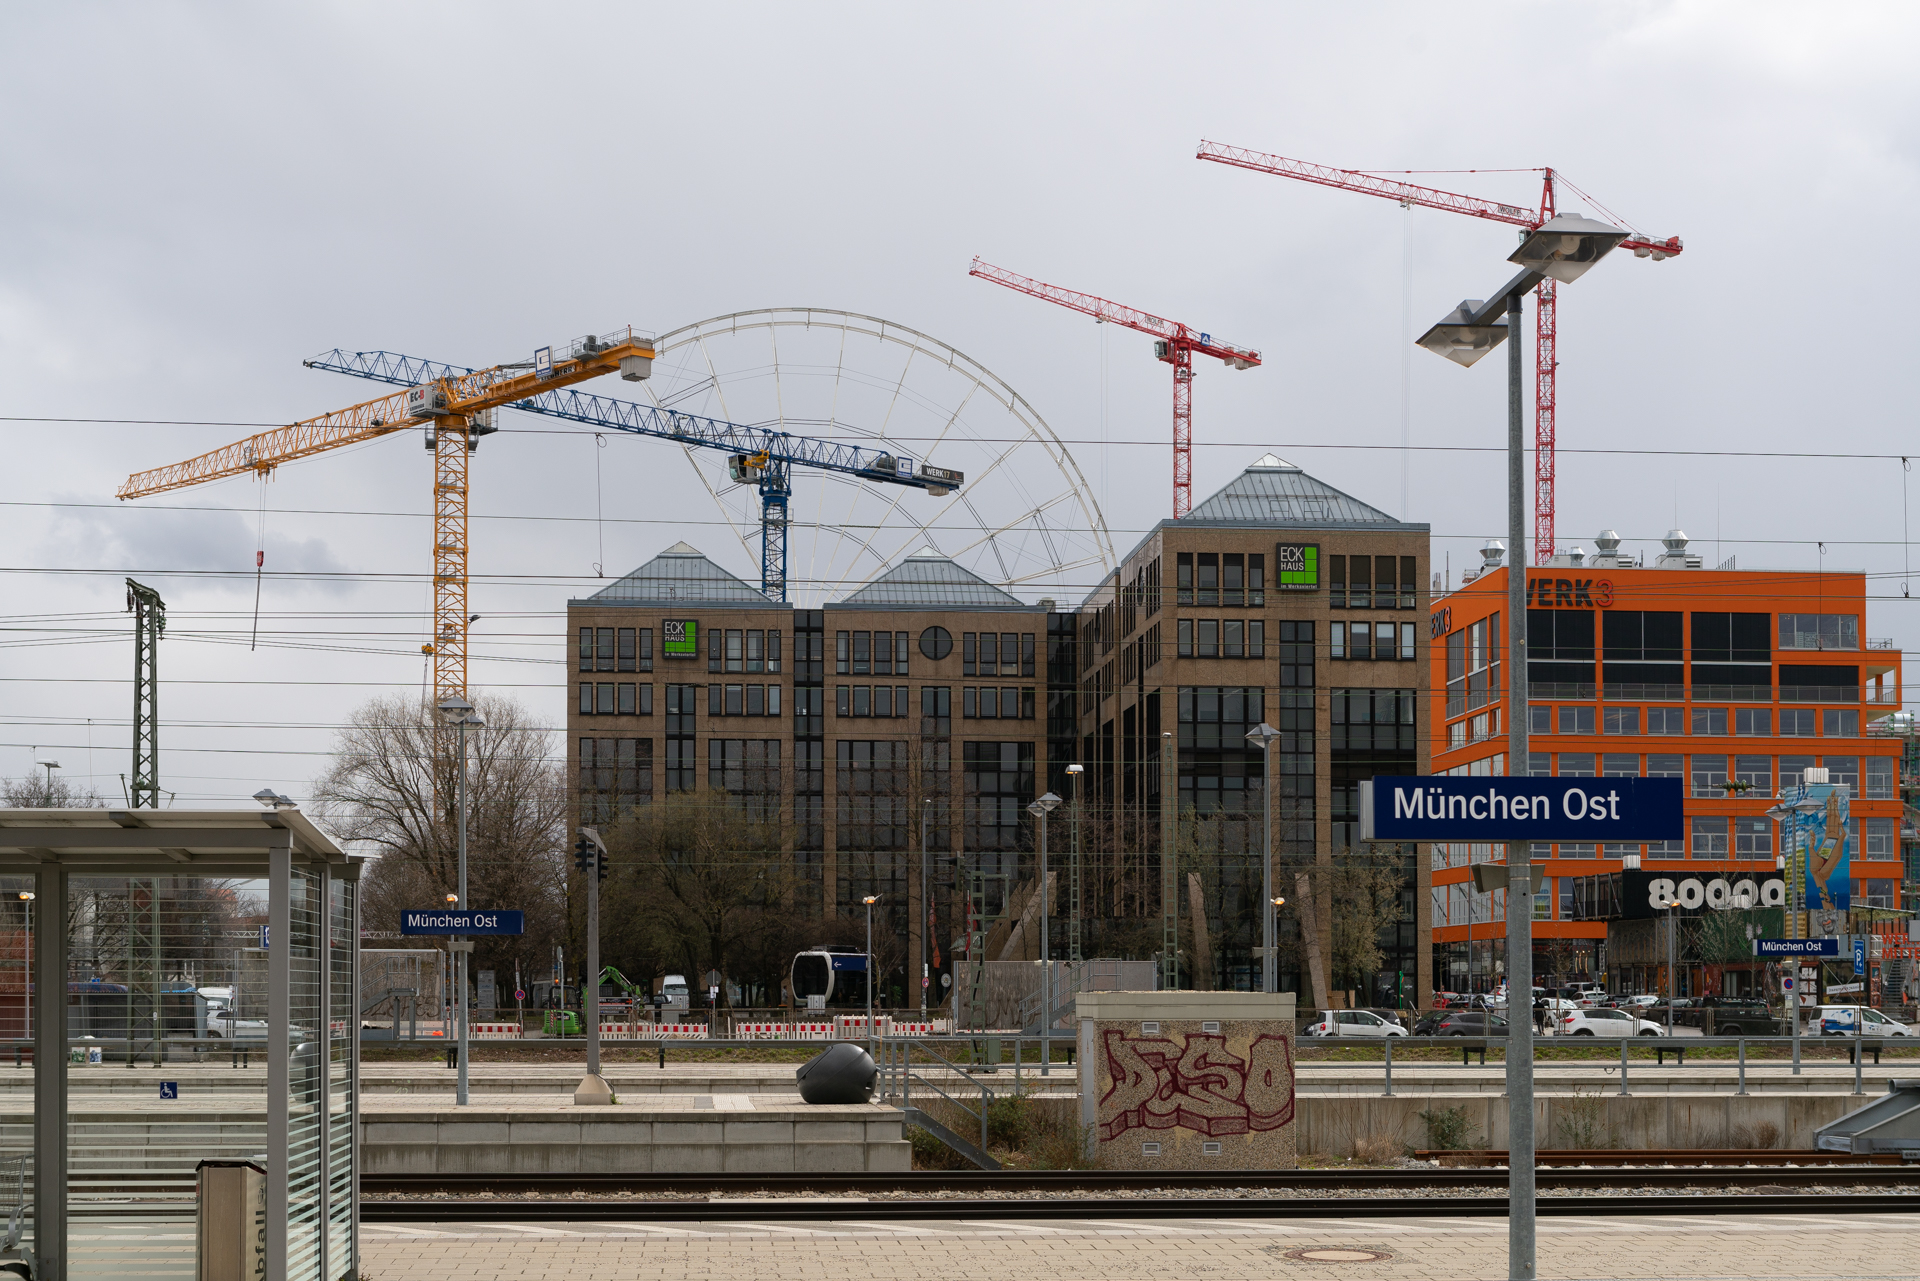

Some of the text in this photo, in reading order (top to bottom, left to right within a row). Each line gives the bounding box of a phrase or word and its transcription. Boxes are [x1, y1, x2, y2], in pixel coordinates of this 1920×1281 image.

[410, 389, 425, 403] EC-B
[926, 467, 950, 479] WERK17
[1280, 546, 1304, 562] ECK
[1280, 562, 1305, 571] HAUS
[664, 621, 685, 634] ECK
[664, 634, 685, 642] HAUS
[1394, 787, 1620, 820] München Ost
[407, 914, 498, 928] München Ost
[1762, 941, 1822, 951] München Ost
[254, 1210, 266, 1281] bfall
